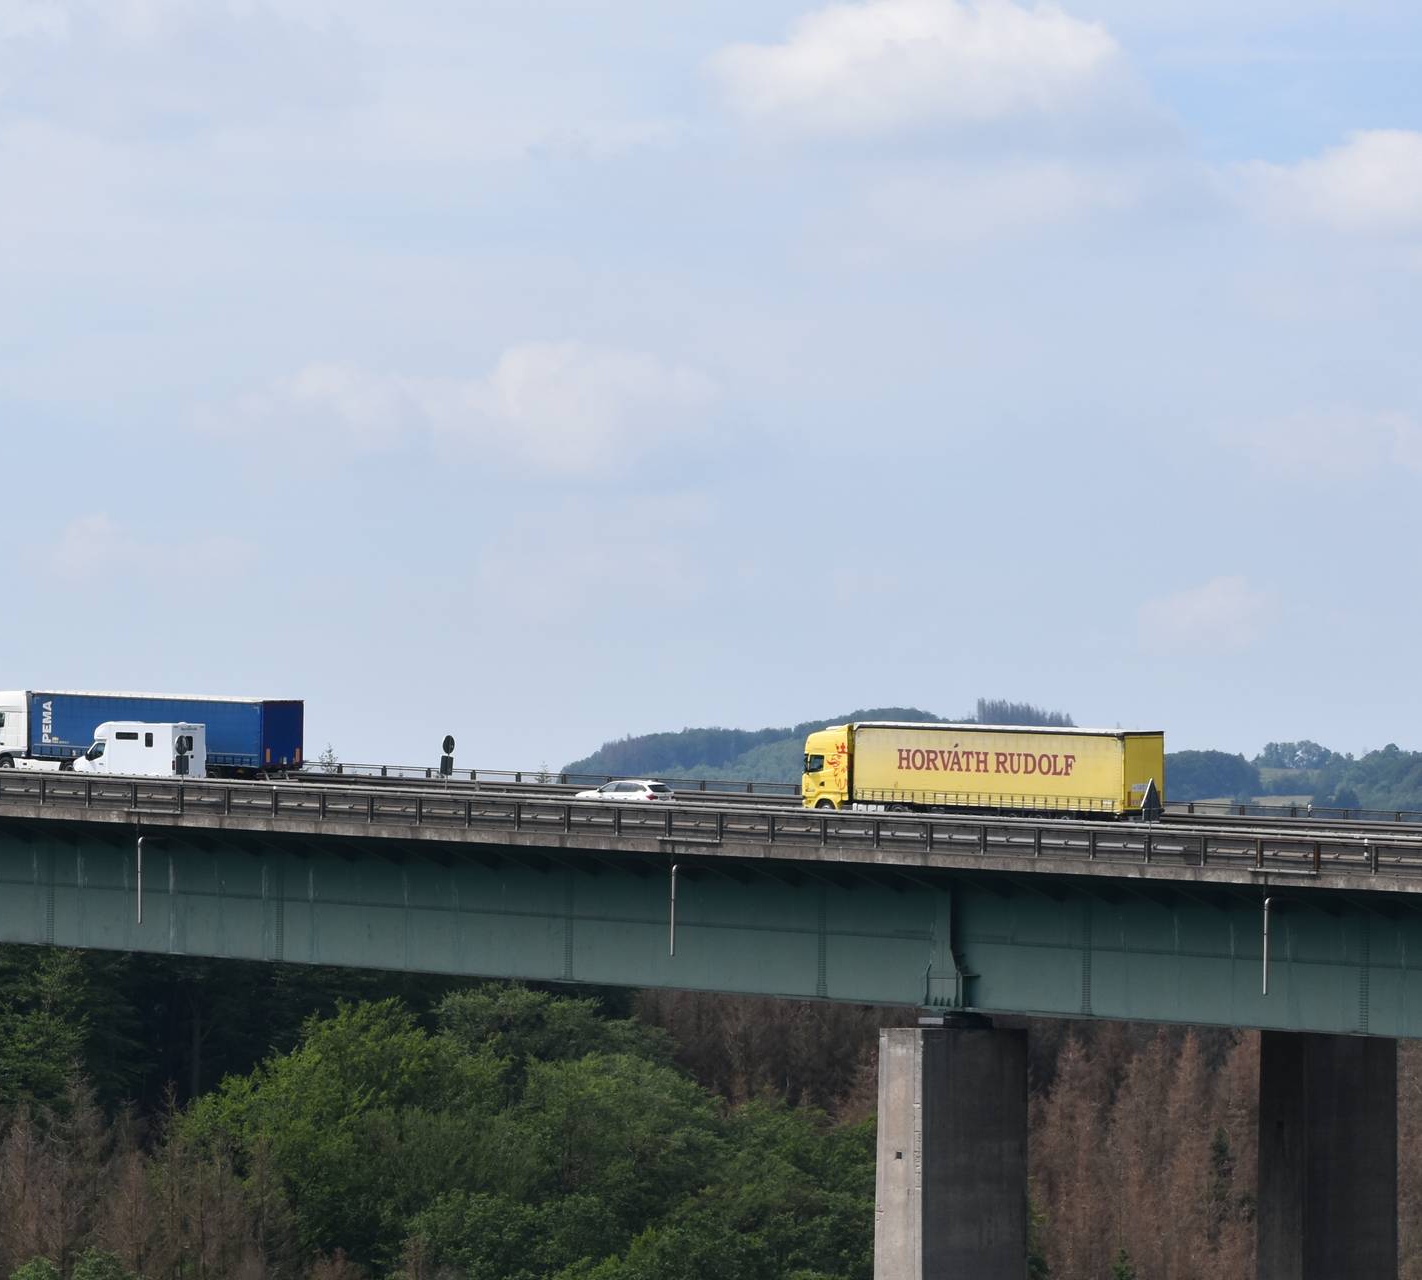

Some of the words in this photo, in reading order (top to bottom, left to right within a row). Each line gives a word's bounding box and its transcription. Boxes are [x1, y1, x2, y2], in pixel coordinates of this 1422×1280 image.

[41, 701, 52, 743] PEMA
[897, 743, 989, 773] HORVÁTH
[994, 752, 1076, 776] RUDOLF
